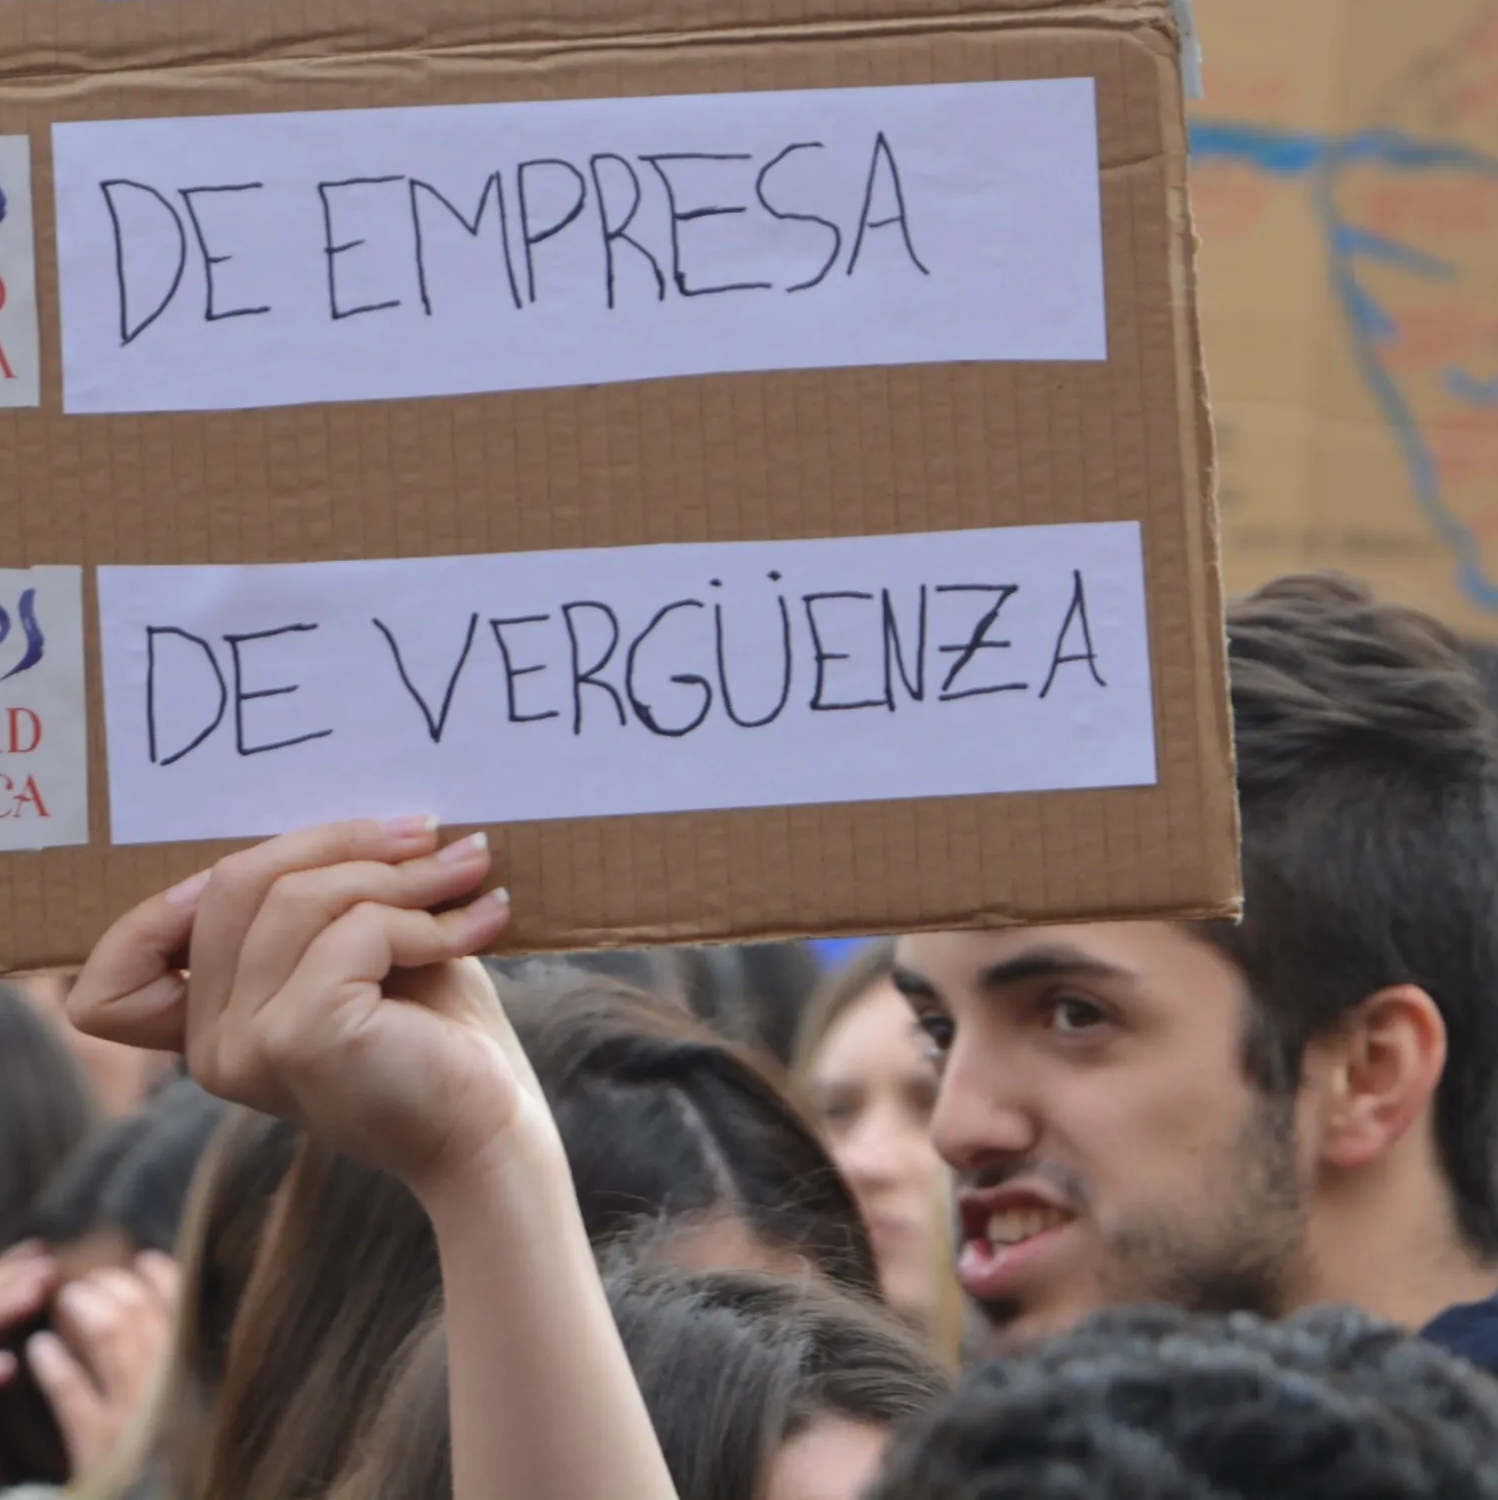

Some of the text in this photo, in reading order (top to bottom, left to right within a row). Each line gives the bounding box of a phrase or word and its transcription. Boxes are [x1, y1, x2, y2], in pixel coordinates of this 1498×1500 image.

[99, 132, 929, 346] DE EMPRESA
[146, 570, 1108, 766] DE VERGÜENZA
